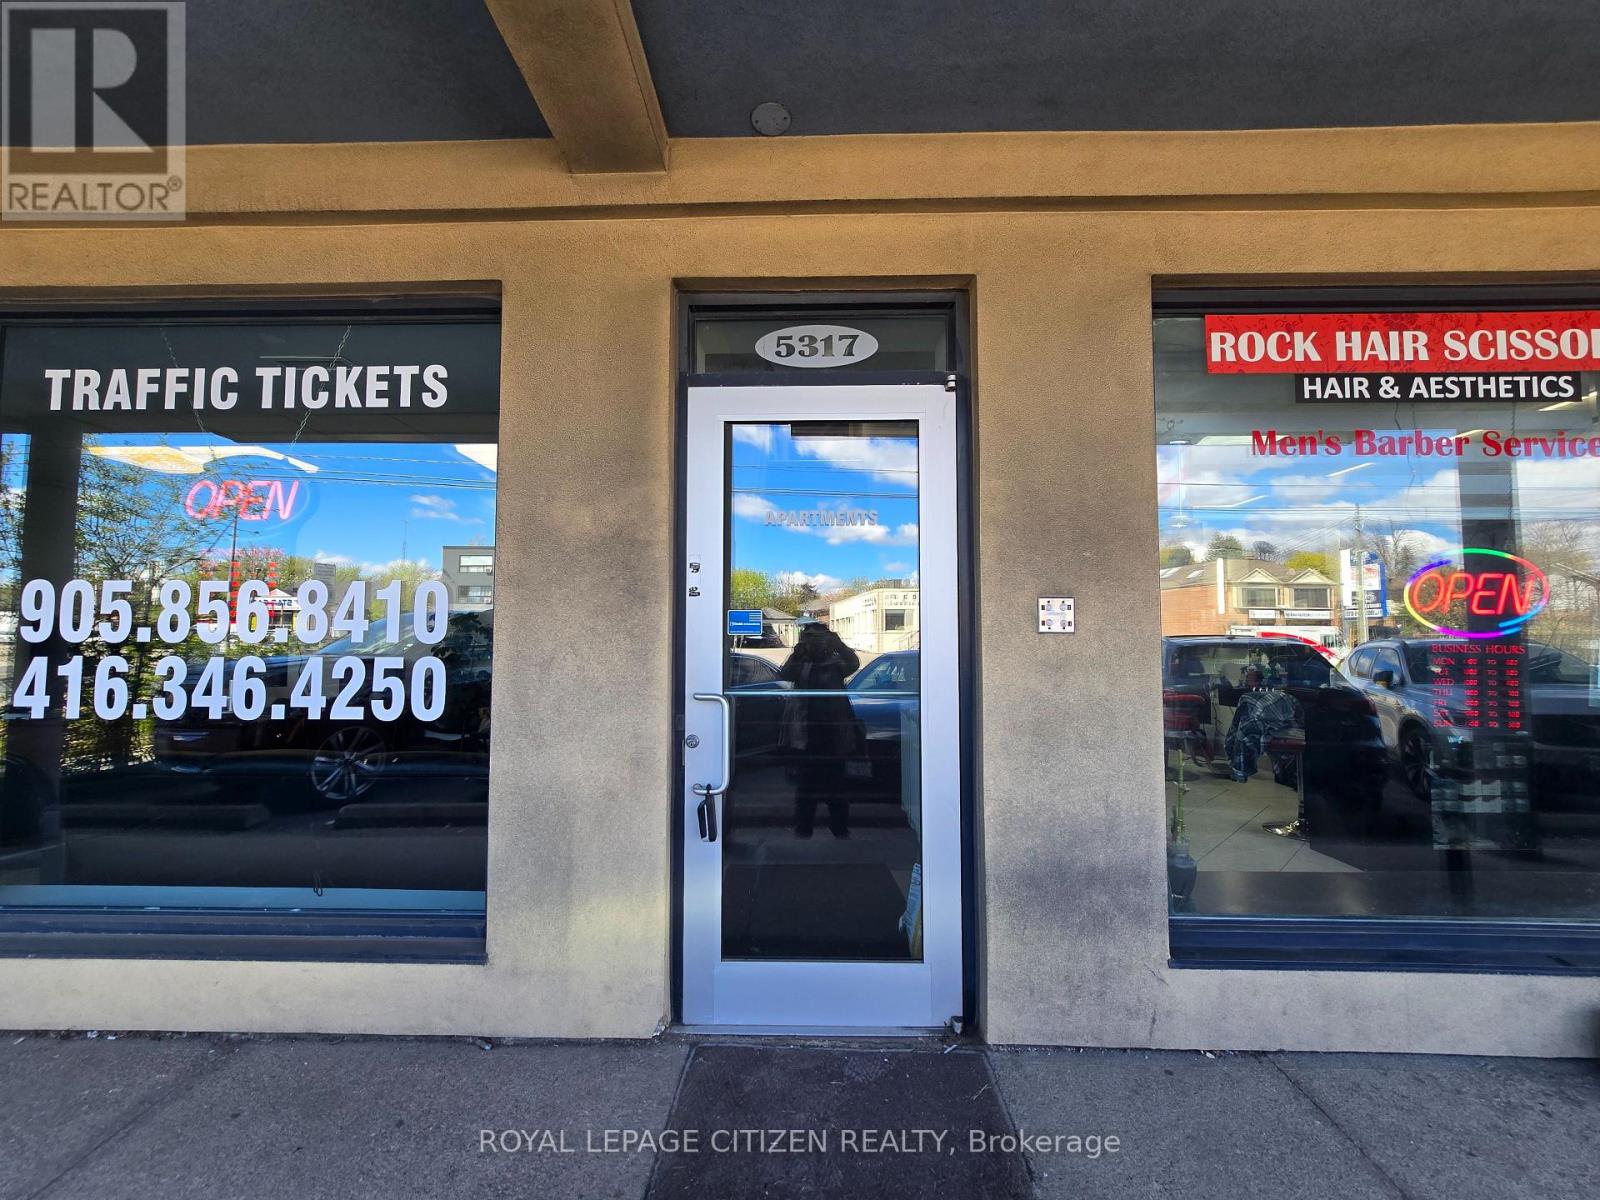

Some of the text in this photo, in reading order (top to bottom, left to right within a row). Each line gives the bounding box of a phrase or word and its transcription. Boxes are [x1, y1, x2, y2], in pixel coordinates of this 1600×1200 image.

[774, 334, 860, 358] 5317
[1210, 331, 1322, 362] ROCK
[1335, 331, 1429, 362] HAIR
[44, 364, 449, 411] TRAFFIC TICKETS
[1302, 375, 1575, 400] HAIR & AESTHETICS
[1250, 429, 1343, 457] Men's
[1353, 428, 1471, 457] Barber
[183, 479, 300, 521] OPEN
[764, 509, 879, 527] APARTMENTS
[1412, 571, 1537, 616] OPEN
[19, 578, 450, 646] 905.856.8410
[1431, 644, 1526, 654] BUSINESS HOURS
[12, 655, 448, 721] 416.346.4250
[1432, 678, 1455, 686] WED
[1432, 688, 1453, 696] THU
